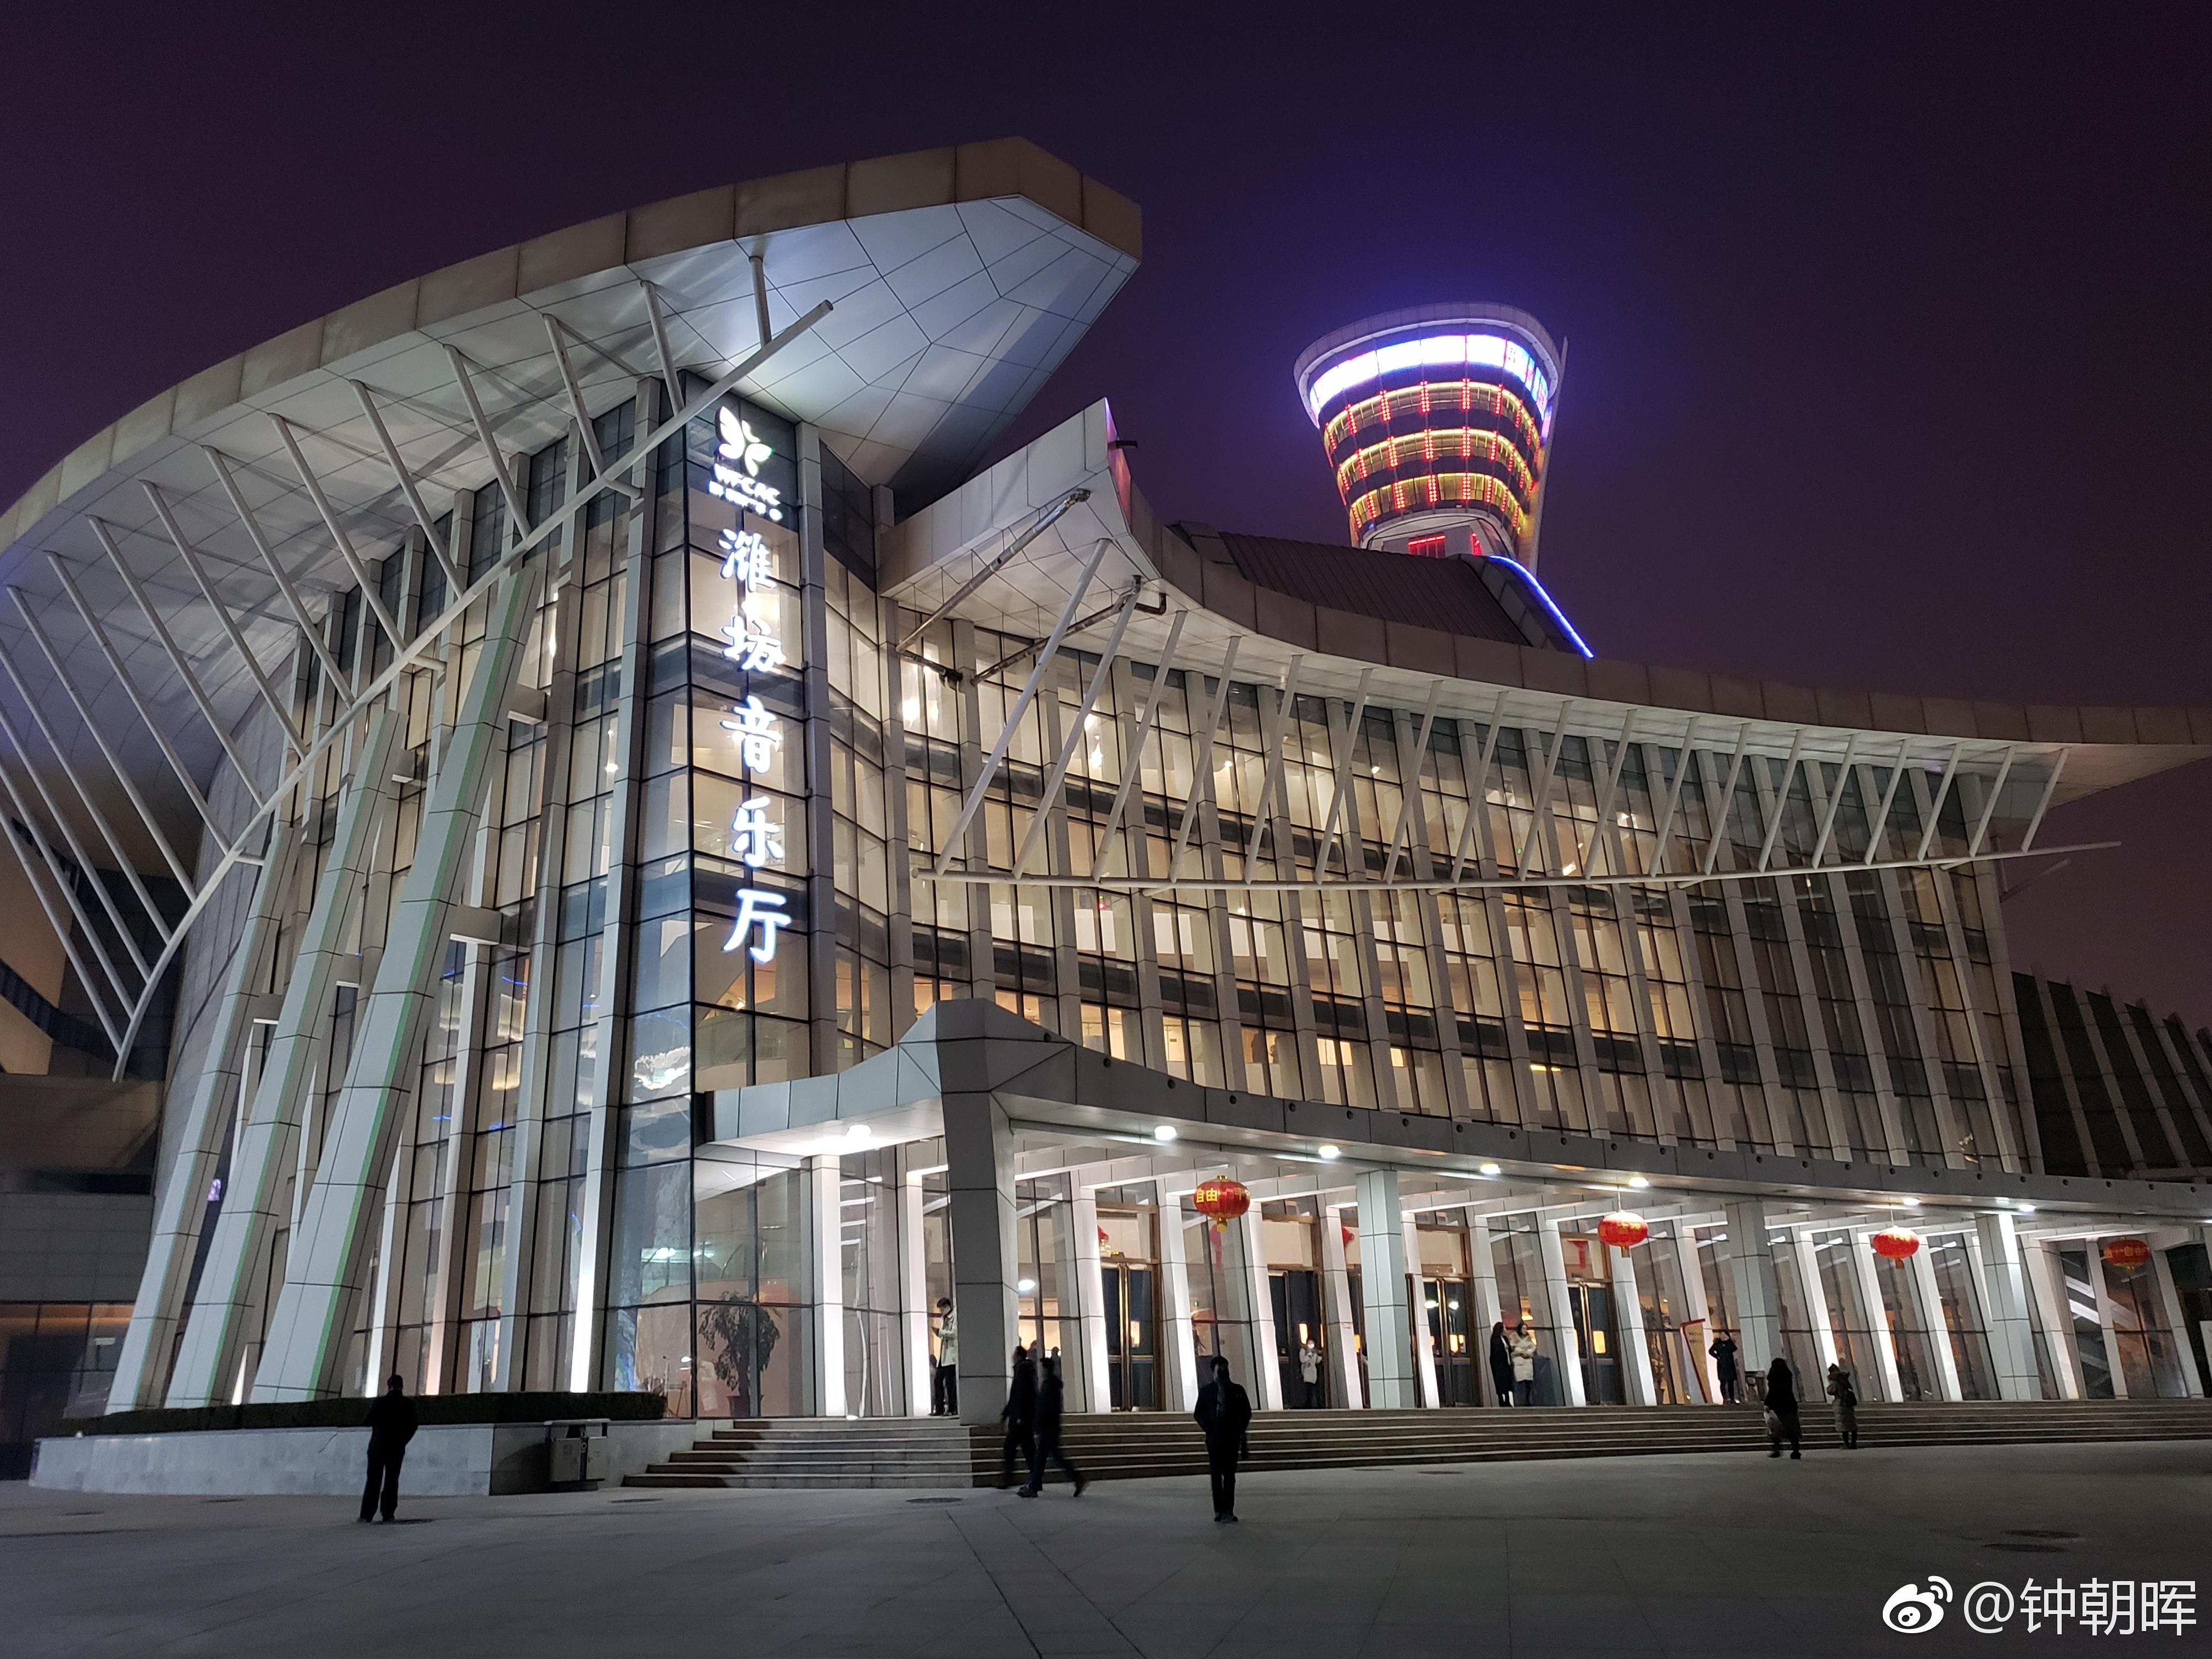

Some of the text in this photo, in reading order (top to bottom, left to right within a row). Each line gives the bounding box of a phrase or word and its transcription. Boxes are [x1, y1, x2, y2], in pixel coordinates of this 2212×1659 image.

[719, 528, 792, 963] 潍坊音乐厅
[1196, 1187, 1218, 1203] 自由
